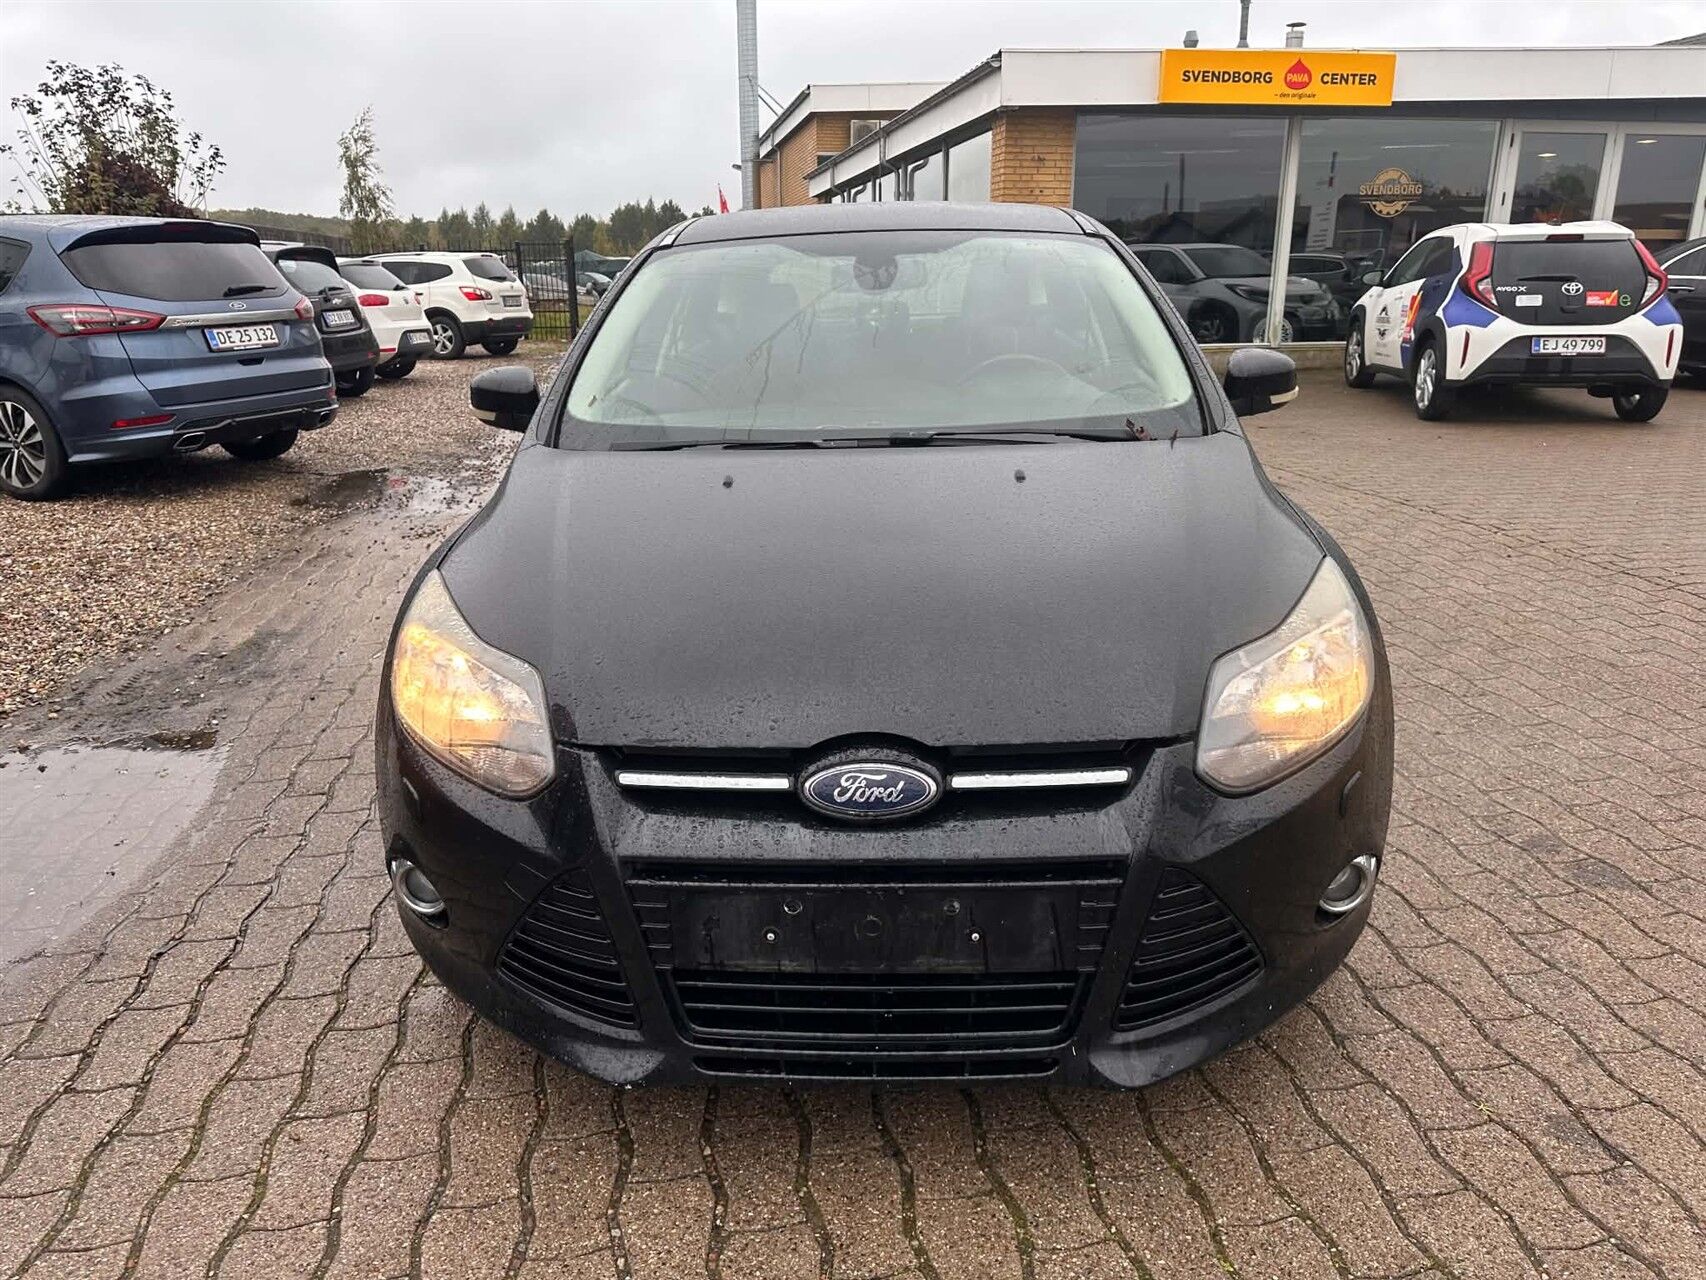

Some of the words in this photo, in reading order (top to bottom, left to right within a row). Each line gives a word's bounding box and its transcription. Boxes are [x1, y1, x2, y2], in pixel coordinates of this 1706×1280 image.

[1182, 70, 1273, 84] SVENDBORG
[1286, 73, 1310, 83] PAVA
[1320, 73, 1377, 85] CENTER
[1291, 92, 1316, 100] originale
[1359, 184, 1422, 195] SVENDBORG
[217, 331, 235, 345] DE
[236, 329, 252, 343] 25
[253, 327, 276, 342] 132
[1542, 340, 1558, 351] EJ
[1562, 339, 1577, 350] 49
[1580, 339, 1603, 350] 799
[833, 772, 905, 803] Ford
